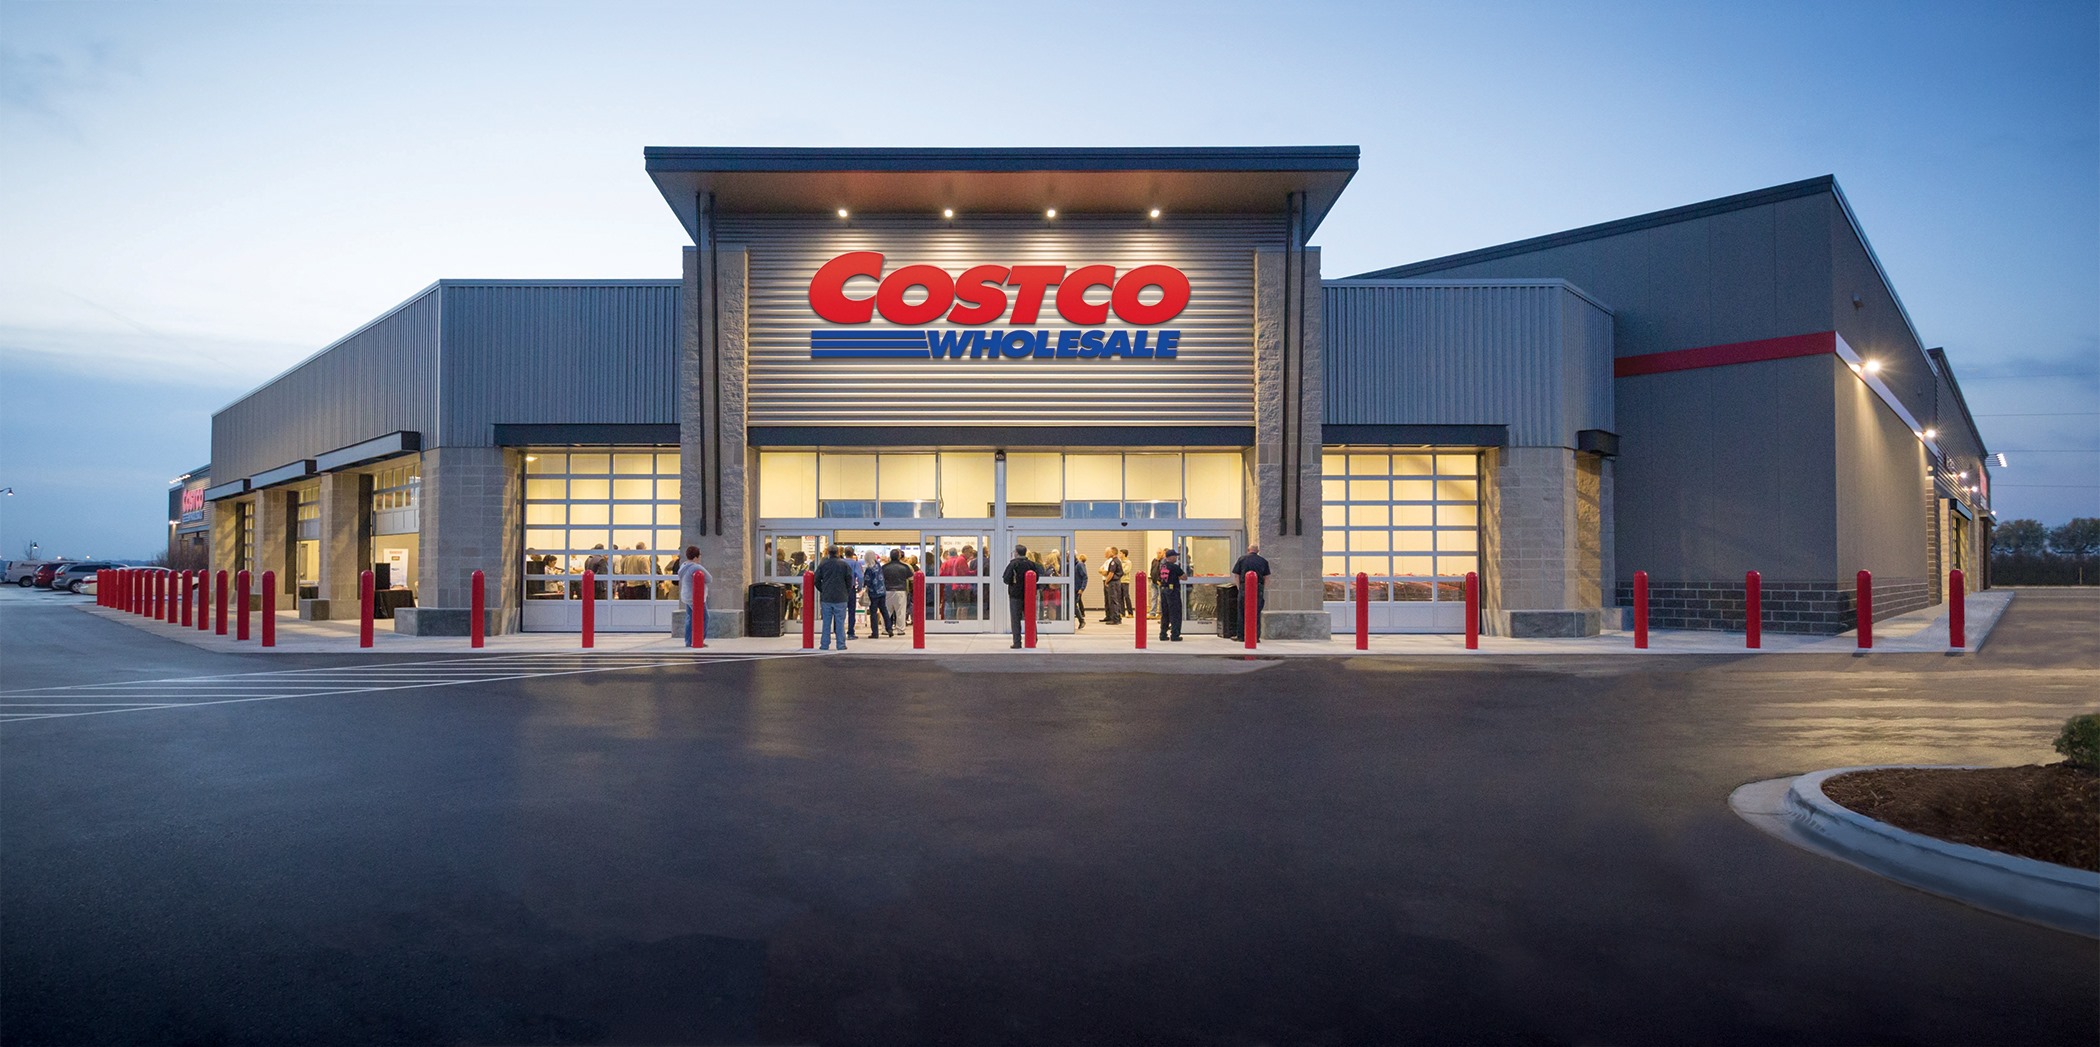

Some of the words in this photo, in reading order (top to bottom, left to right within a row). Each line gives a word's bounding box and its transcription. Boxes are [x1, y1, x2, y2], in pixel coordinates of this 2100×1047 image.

[809, 251, 1190, 325] COSTCO
[927, 330, 1181, 358] WHOLESALE
[182, 488, 204, 513] COSTCO
